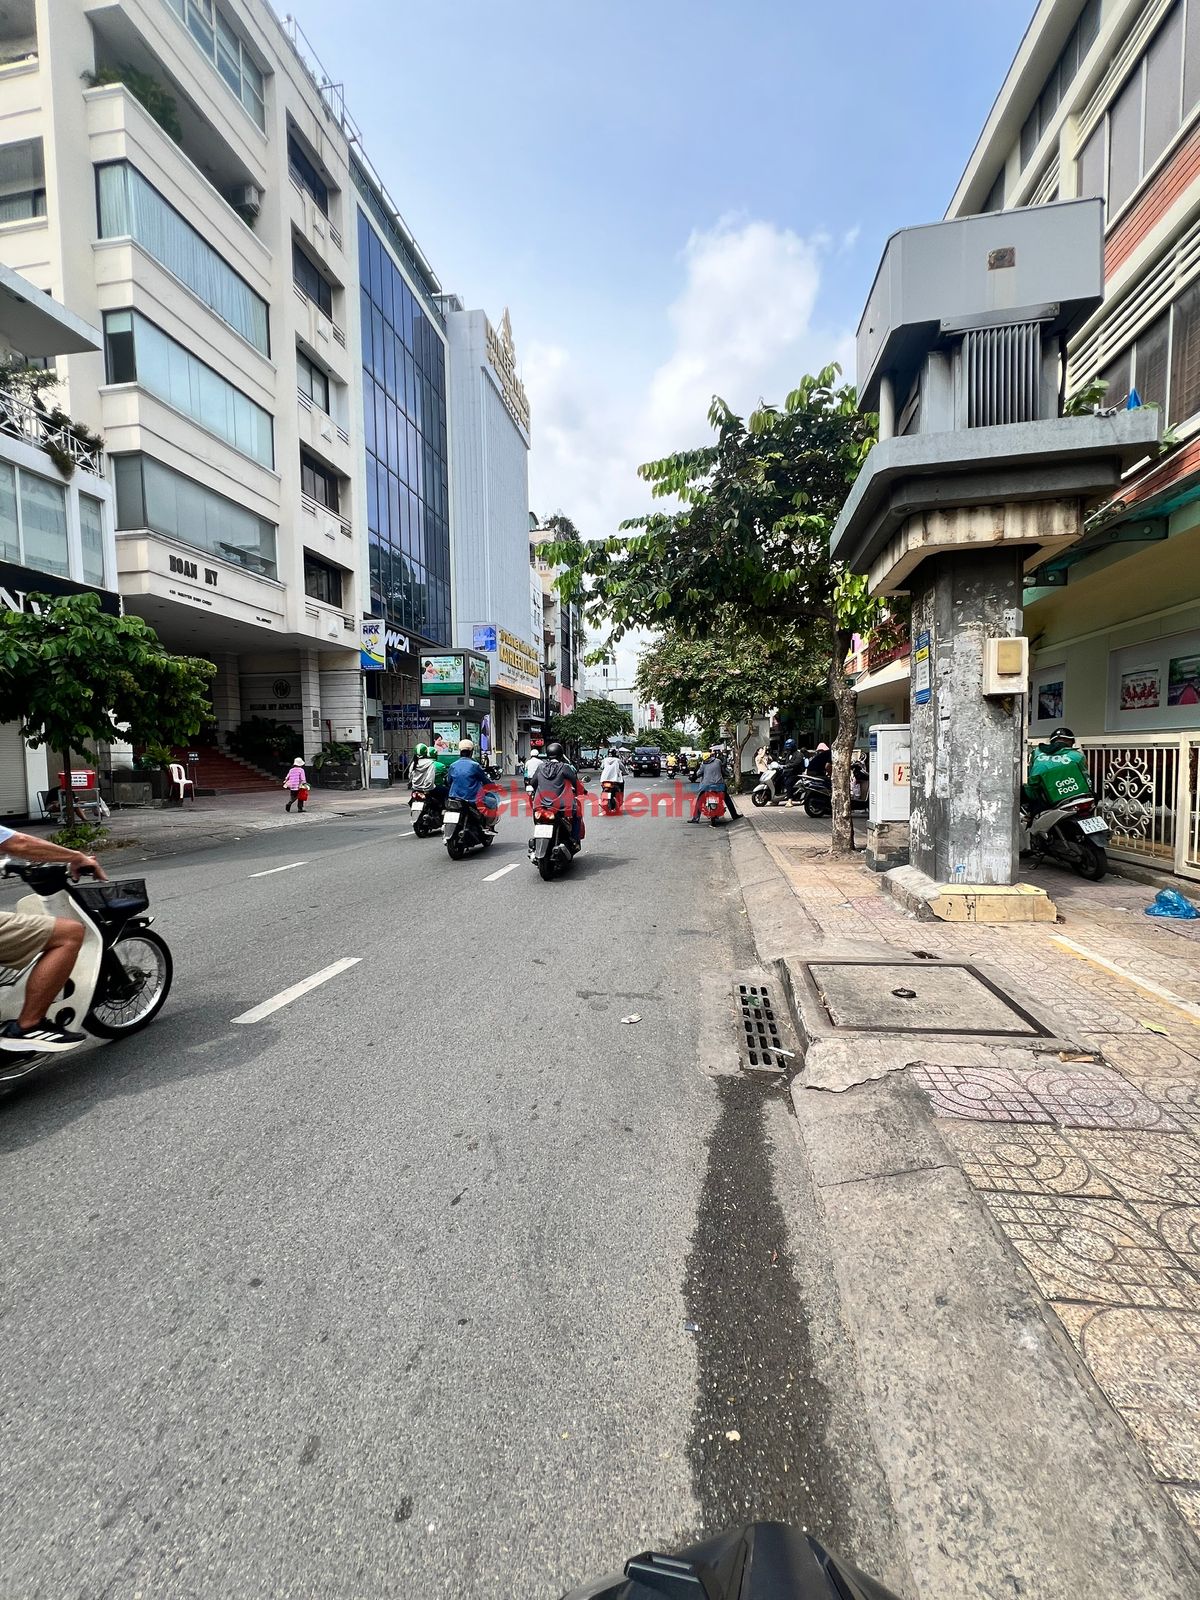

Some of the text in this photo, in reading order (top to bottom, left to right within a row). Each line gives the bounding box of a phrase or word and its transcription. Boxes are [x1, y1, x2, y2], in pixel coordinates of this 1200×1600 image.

[169, 554, 218, 587] HOAN MY
[1055, 777, 1076, 788] Grab
[1057, 783, 1079, 795] Food
